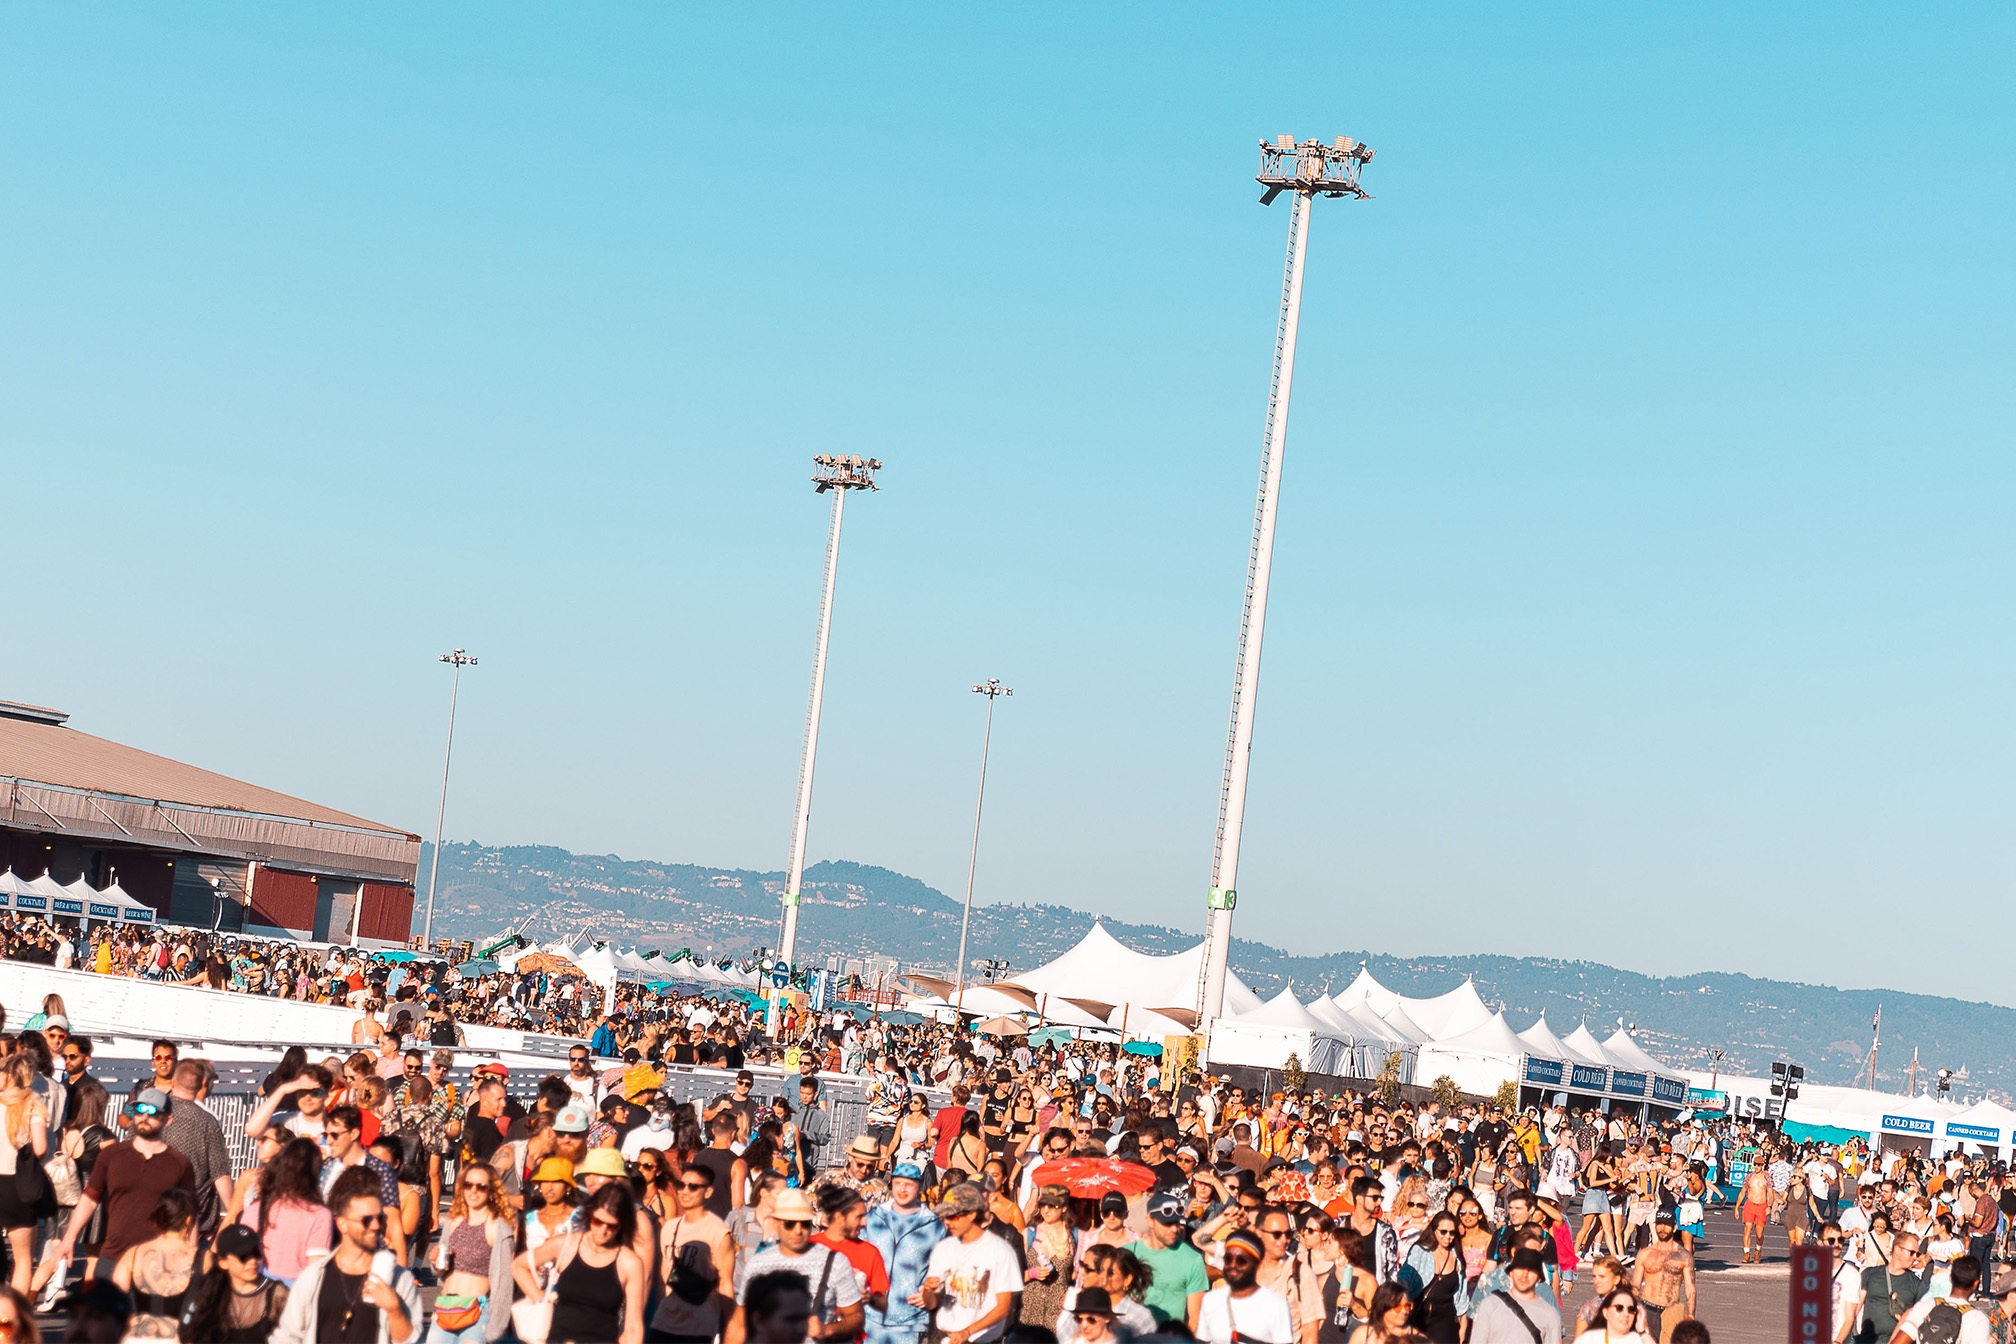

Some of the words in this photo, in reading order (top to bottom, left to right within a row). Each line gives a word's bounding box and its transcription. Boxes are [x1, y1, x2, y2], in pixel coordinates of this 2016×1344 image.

[18, 897, 46, 907] COCKTAILS
[1210, 890, 1221, 906] 3
[1228, 892, 1236, 909] 3
[90, 905, 117, 915] COCKTAILS
[1164, 1048, 1172, 1080] VIP
[1573, 1069, 1590, 1083] COLD
[1590, 1072, 1605, 1085] BEER
[1655, 1081, 1669, 1095] COLD
[1669, 1084, 1683, 1098] BEER
[1884, 1117, 1908, 1128] COLD
[1909, 1120, 1931, 1131] BEER
[1947, 1126, 1969, 1135] CANNED
[1969, 1128, 1998, 1138] COCKTAILS
[1803, 1257, 1818, 1291] DO
[1802, 1303, 1817, 1344] NO
